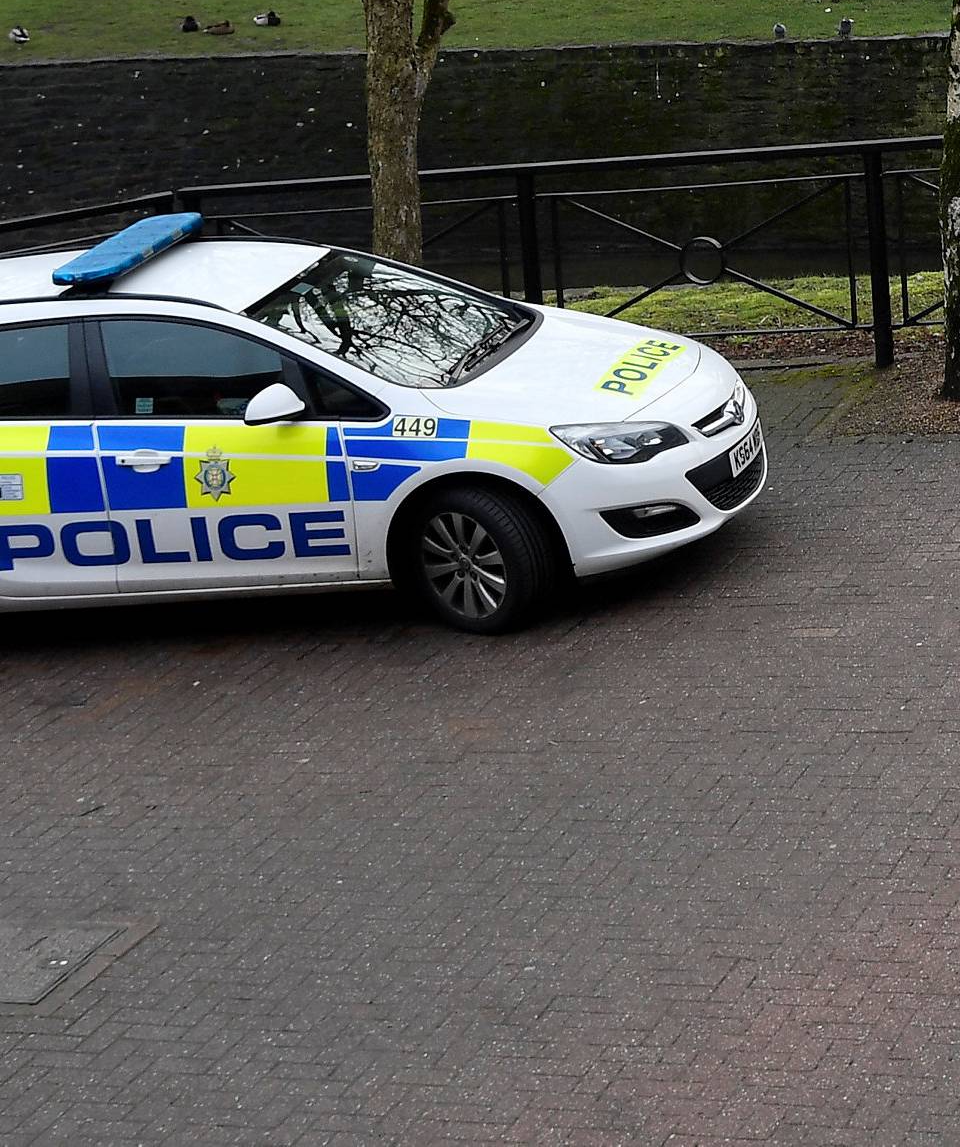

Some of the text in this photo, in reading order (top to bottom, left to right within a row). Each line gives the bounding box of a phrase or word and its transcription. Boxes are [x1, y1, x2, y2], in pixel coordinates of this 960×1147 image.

[600, 340, 681, 395] POLICE
[394, 417, 436, 437] 449
[0, 510, 351, 571] POLICE
